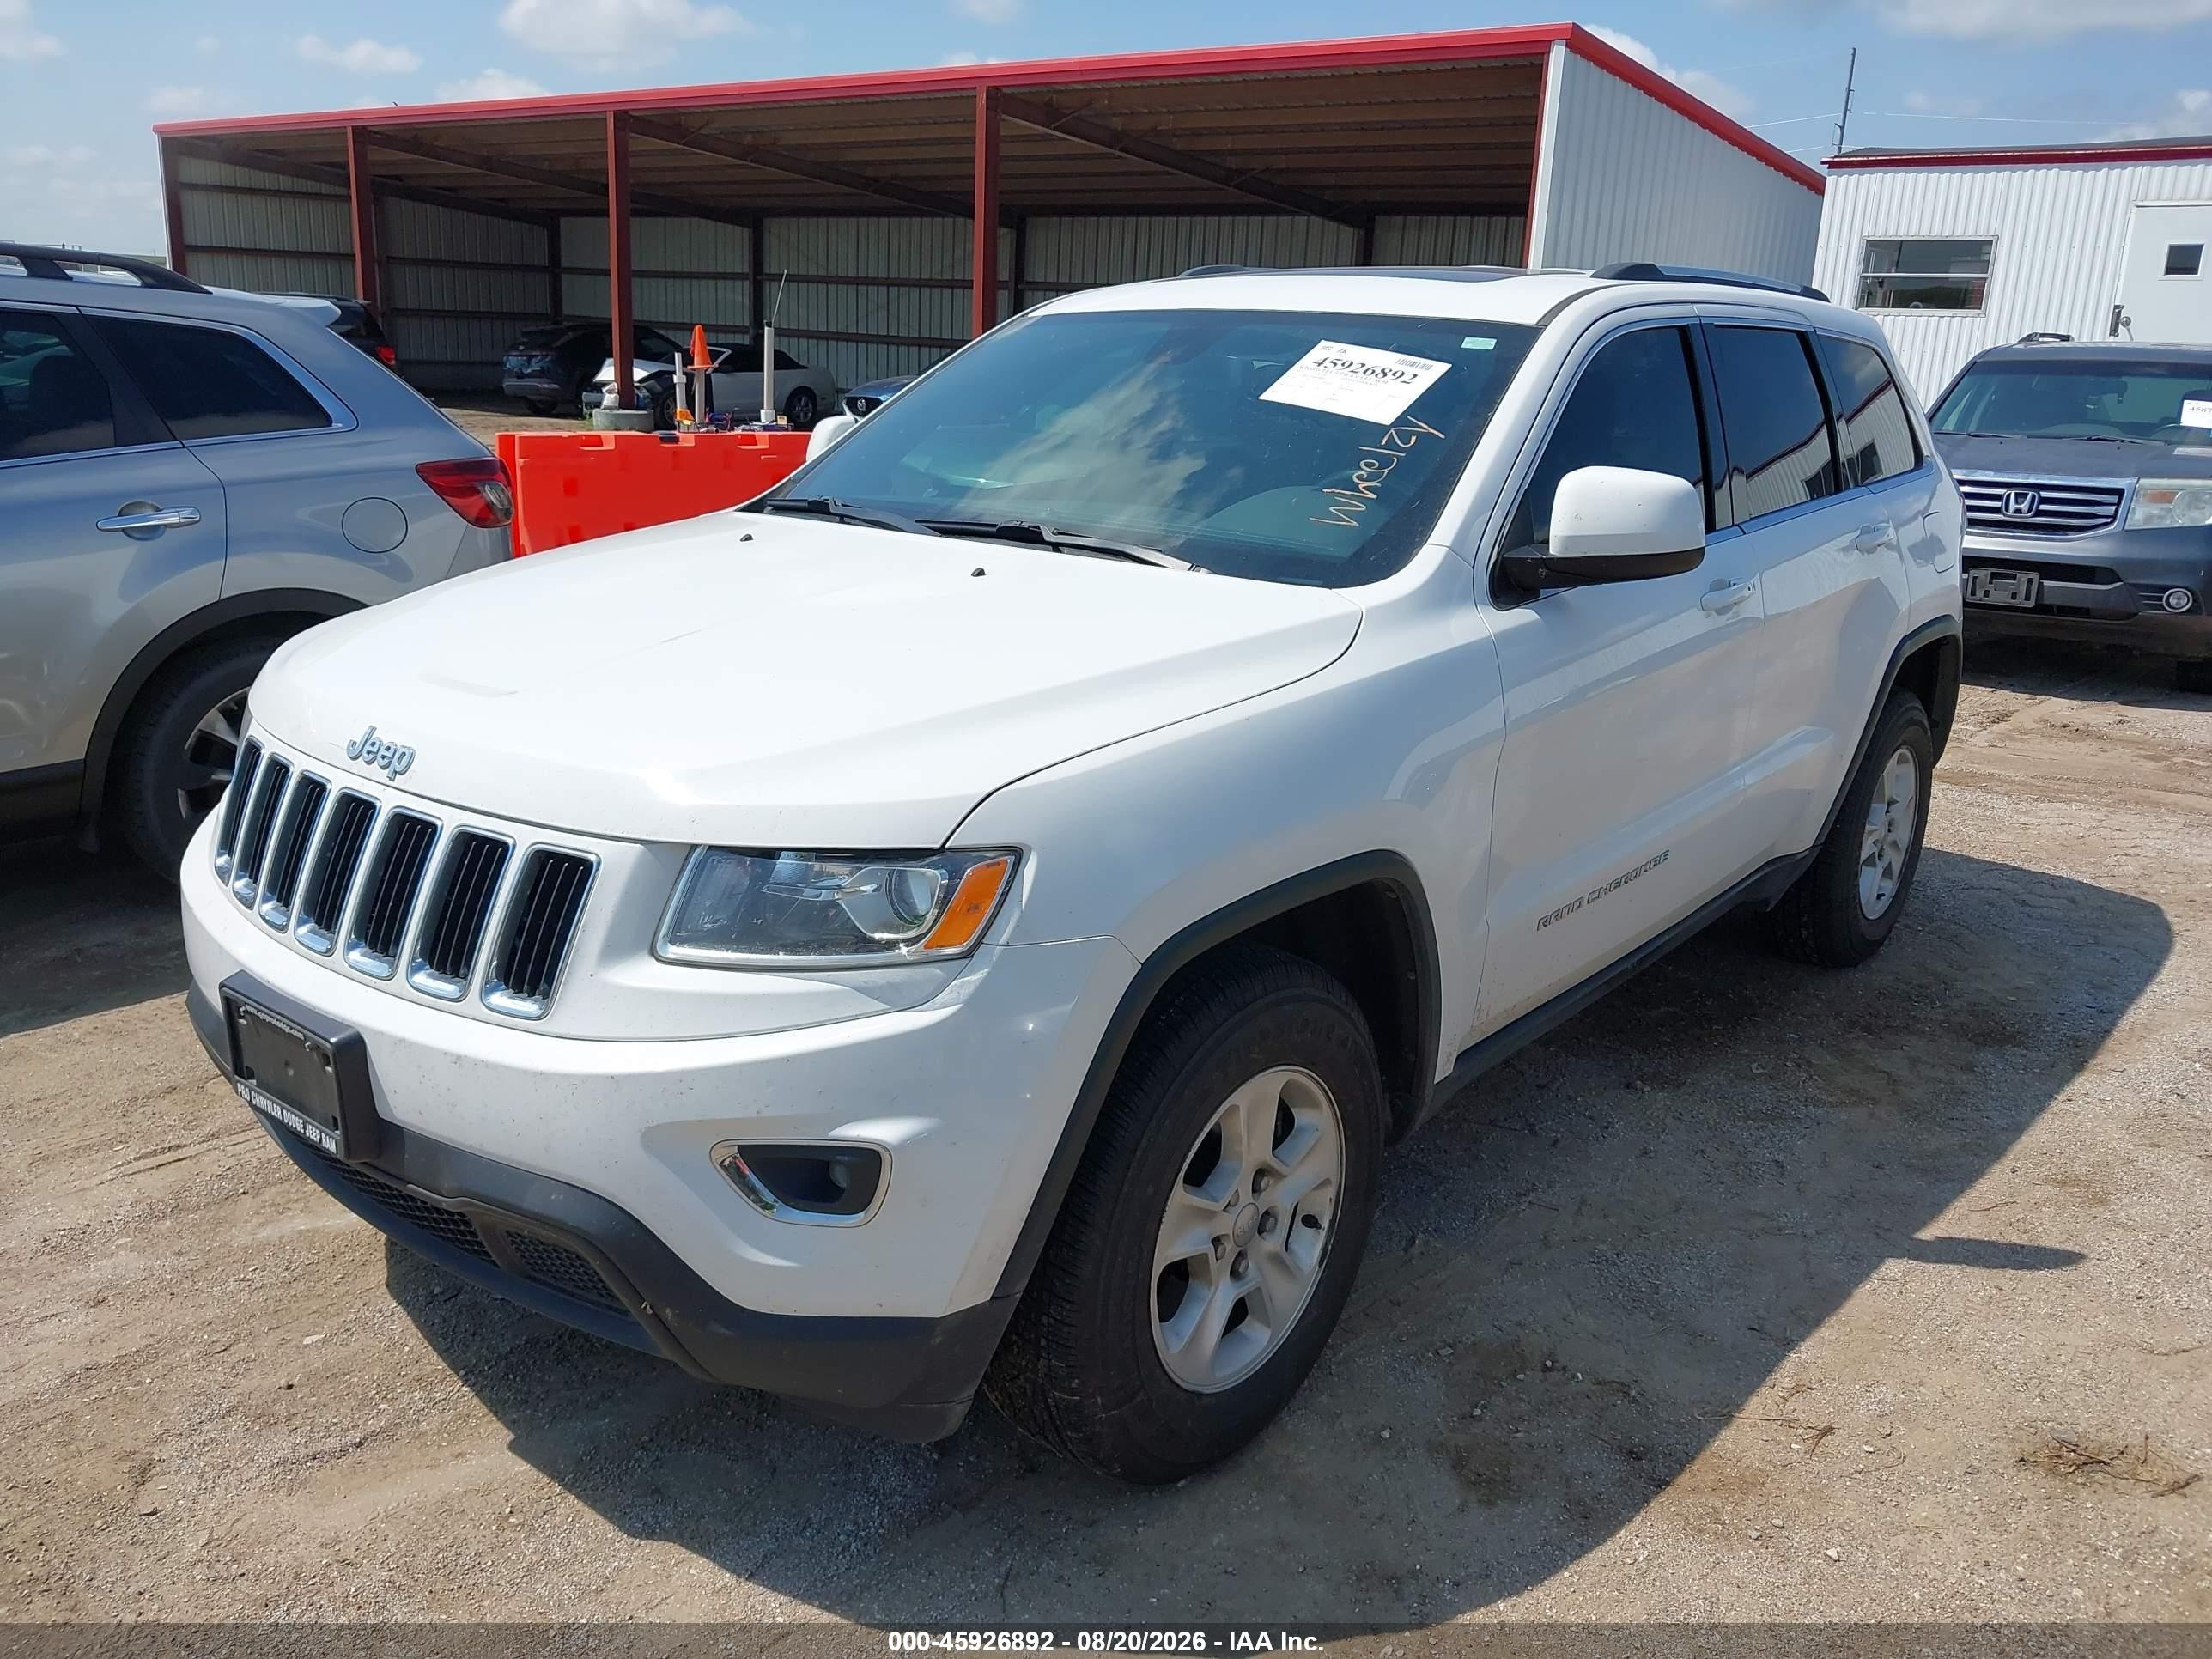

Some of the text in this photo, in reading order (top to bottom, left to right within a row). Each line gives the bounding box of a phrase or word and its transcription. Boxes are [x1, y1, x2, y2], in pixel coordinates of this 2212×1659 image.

[1312, 356, 1419, 384] 45926892
[347, 726, 416, 782] Jeep
[1587, 849, 1670, 904] CHEROKEE
[237, 1082, 337, 1154] PRO CHRYSLER DODGE JEEP RAM
